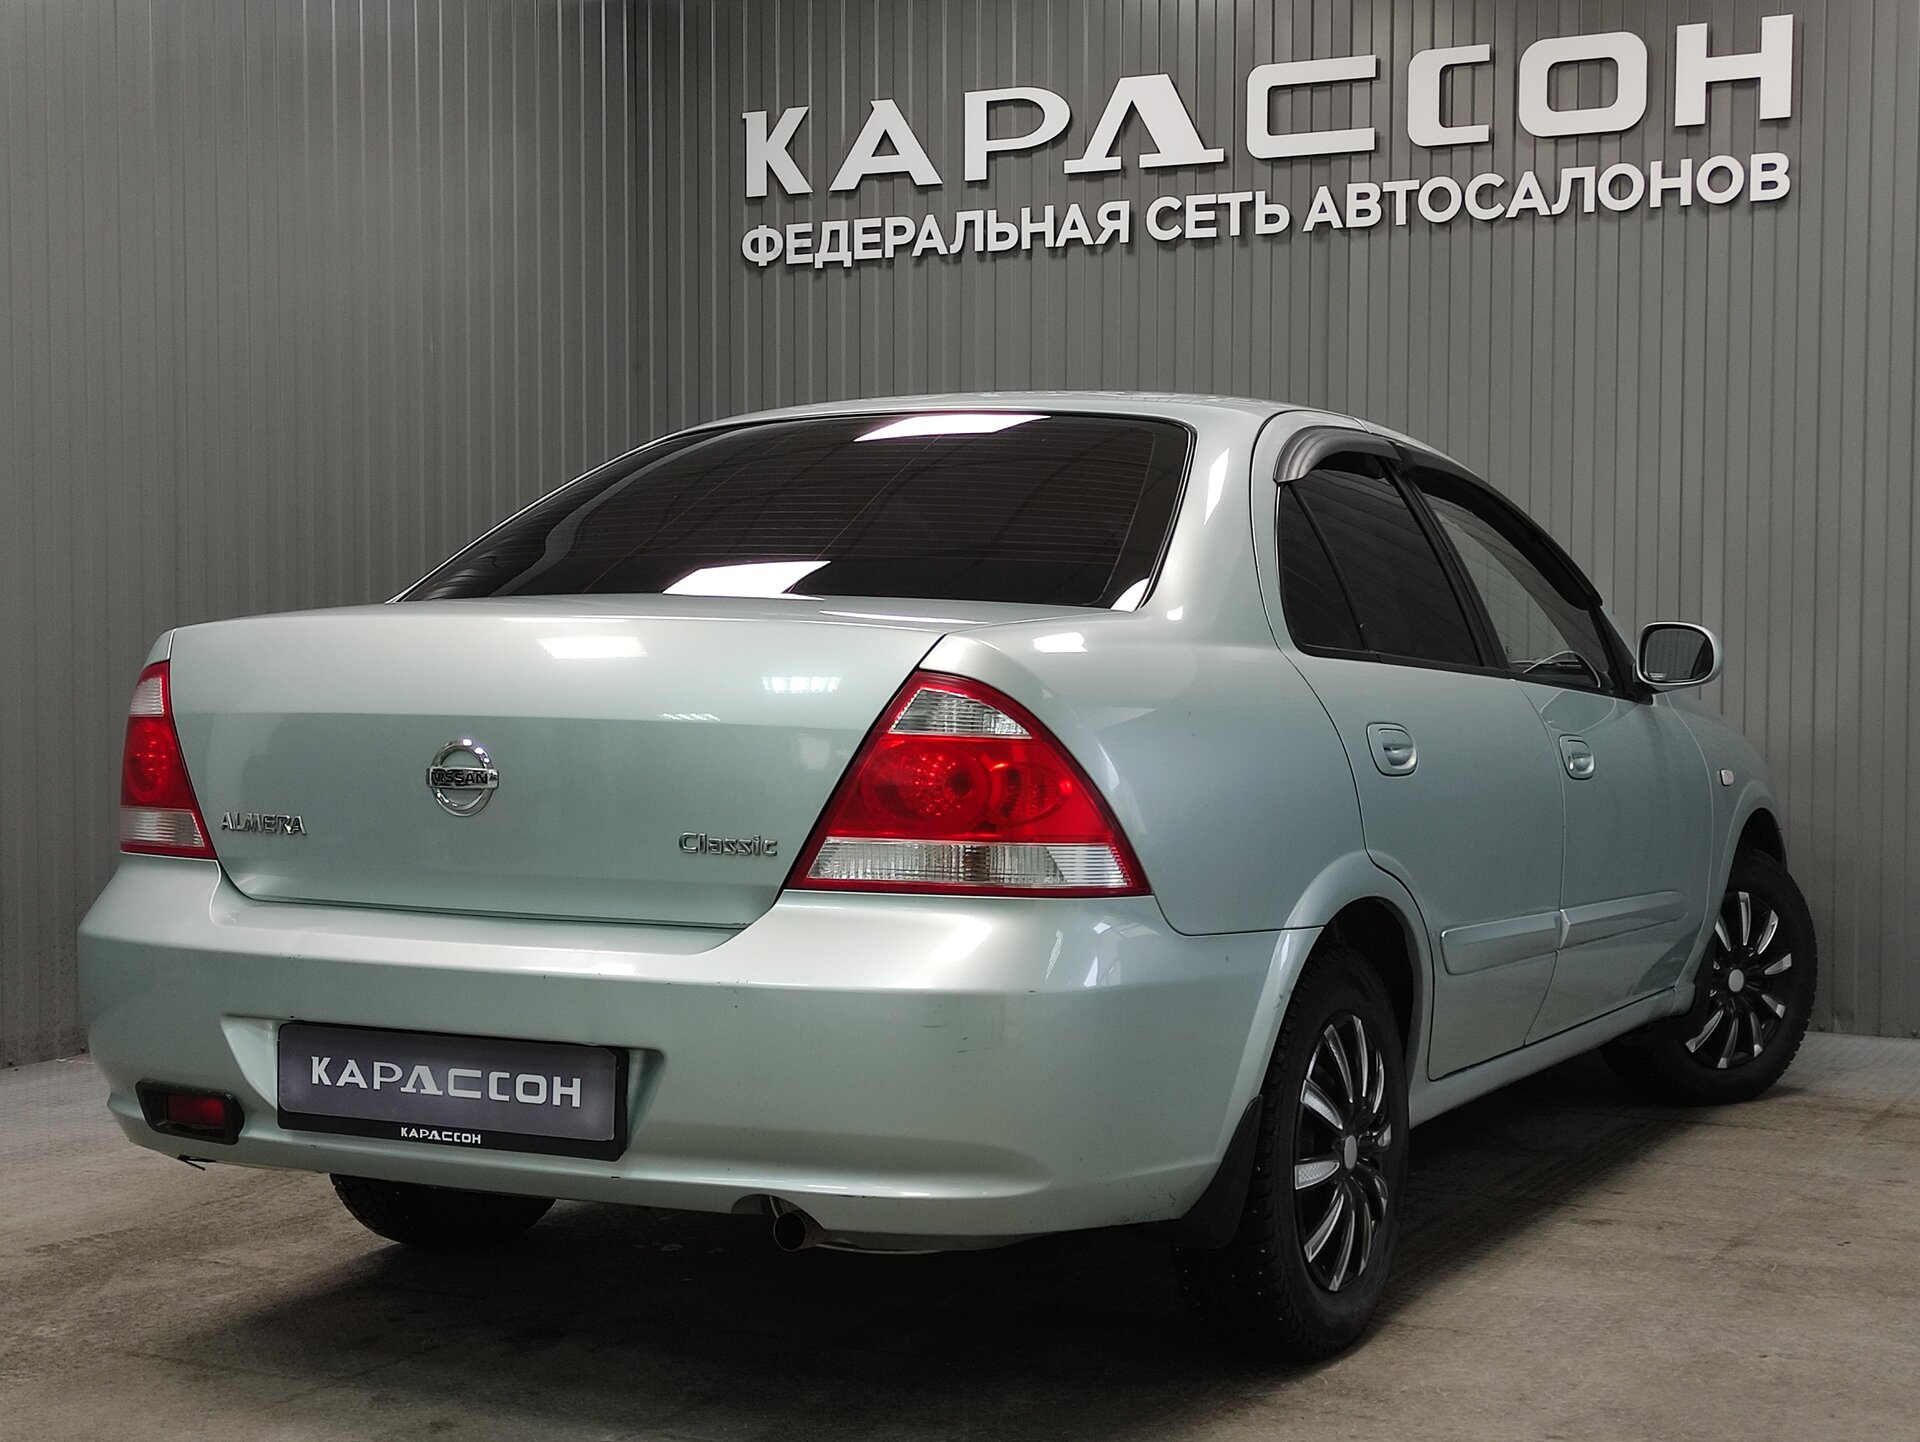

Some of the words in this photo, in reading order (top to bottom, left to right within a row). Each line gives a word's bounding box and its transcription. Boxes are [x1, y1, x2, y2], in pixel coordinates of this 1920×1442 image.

[742, 14, 1794, 198] КАРАССОН
[741, 201, 1130, 269] ФЕДЕРАЛЬНАЯ
[1146, 191, 1290, 241] СЕТЬ
[1302, 153, 1791, 232] АВТОСАЛОНОВ
[430, 770, 489, 785] NISSAN
[220, 812, 307, 835] ALMERA
[679, 831, 778, 857] Classic
[310, 1056, 581, 1107] КАРАССОН
